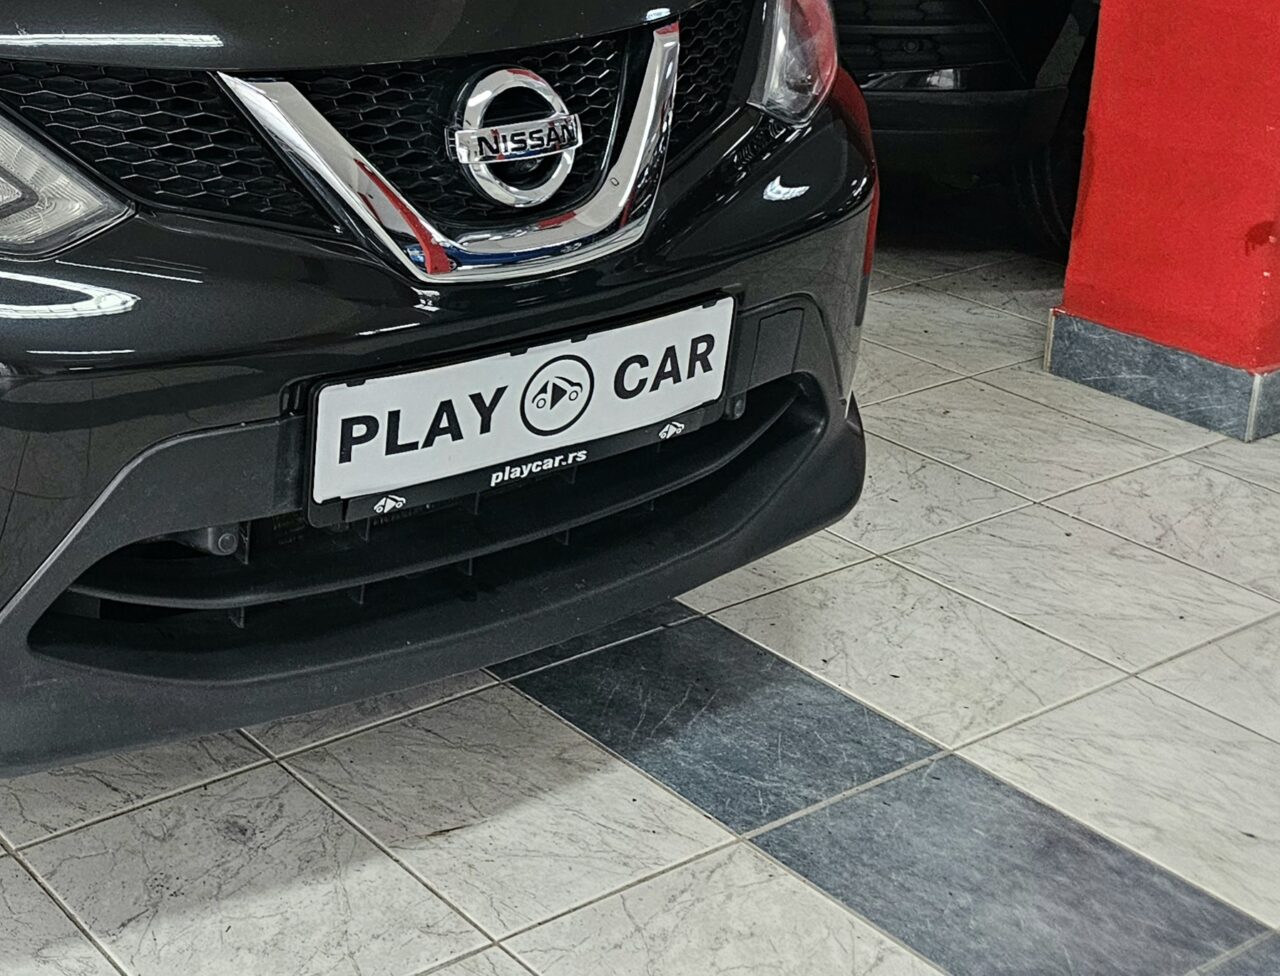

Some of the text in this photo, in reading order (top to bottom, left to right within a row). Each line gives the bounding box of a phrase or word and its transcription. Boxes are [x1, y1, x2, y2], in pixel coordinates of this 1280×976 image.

[477, 118, 577, 156] NISSAN
[338, 333, 715, 464] PLAY CAR
[490, 449, 588, 487] playcar.rs
